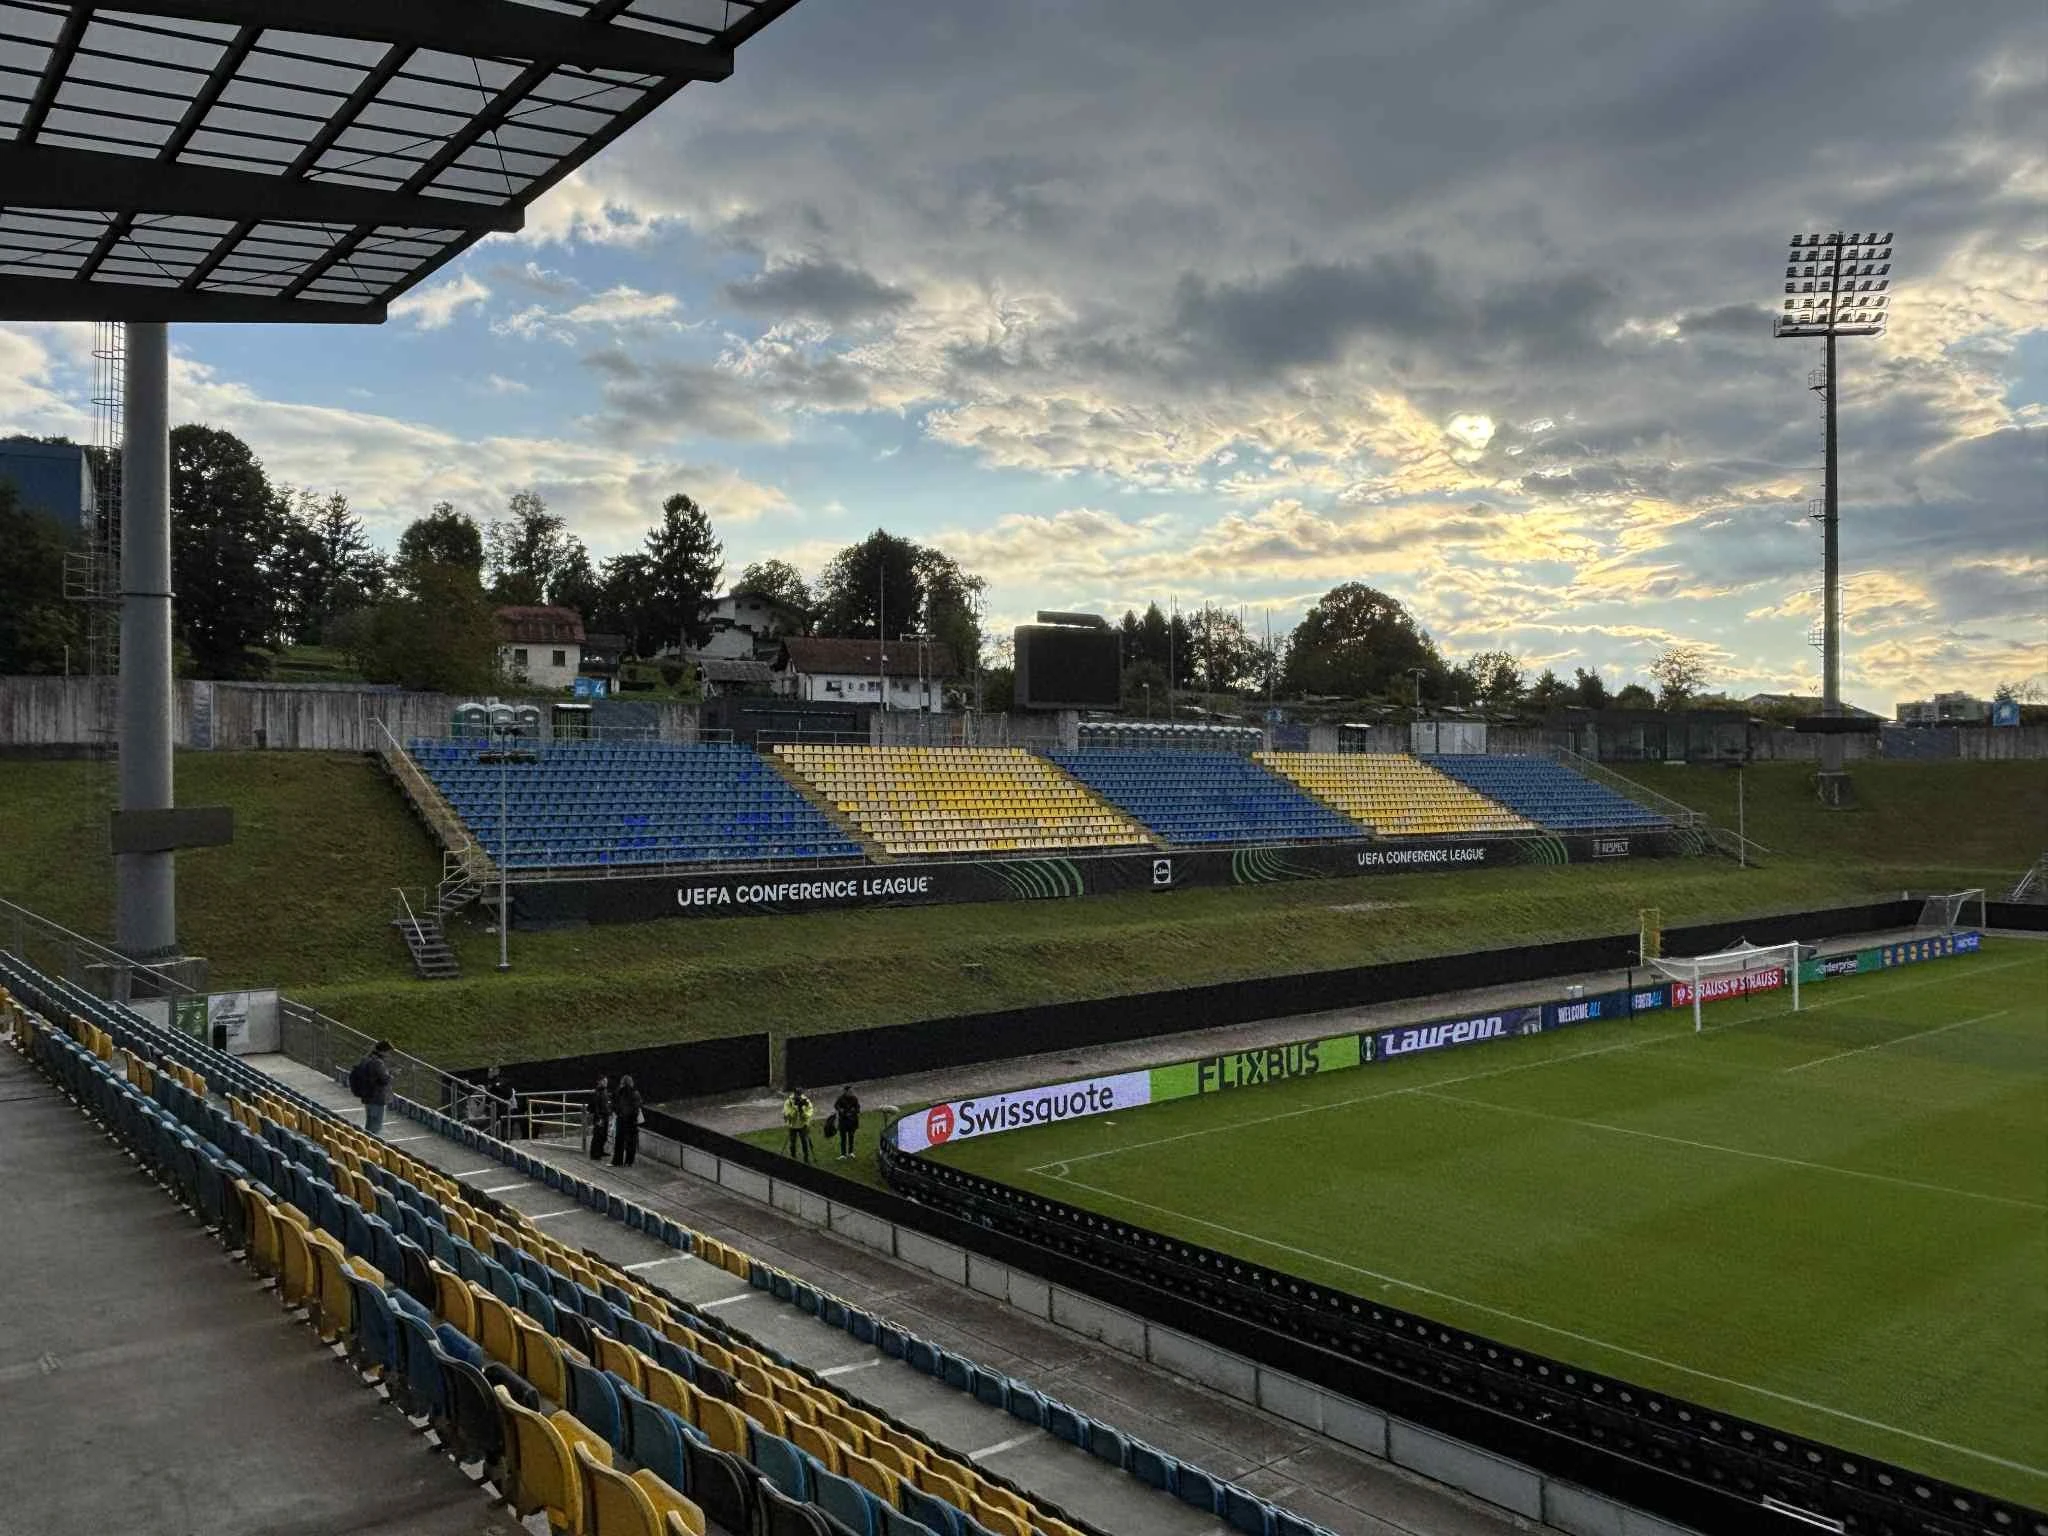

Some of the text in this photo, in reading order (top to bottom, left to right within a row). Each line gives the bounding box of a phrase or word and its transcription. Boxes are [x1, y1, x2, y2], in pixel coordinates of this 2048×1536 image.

[1358, 848, 1485, 866] UEFA CONFERENCE LEAGUE
[677, 877, 929, 906] UEFA CONFERENCE LEAGUE
[958, 1083, 1114, 1136] Swissquote
